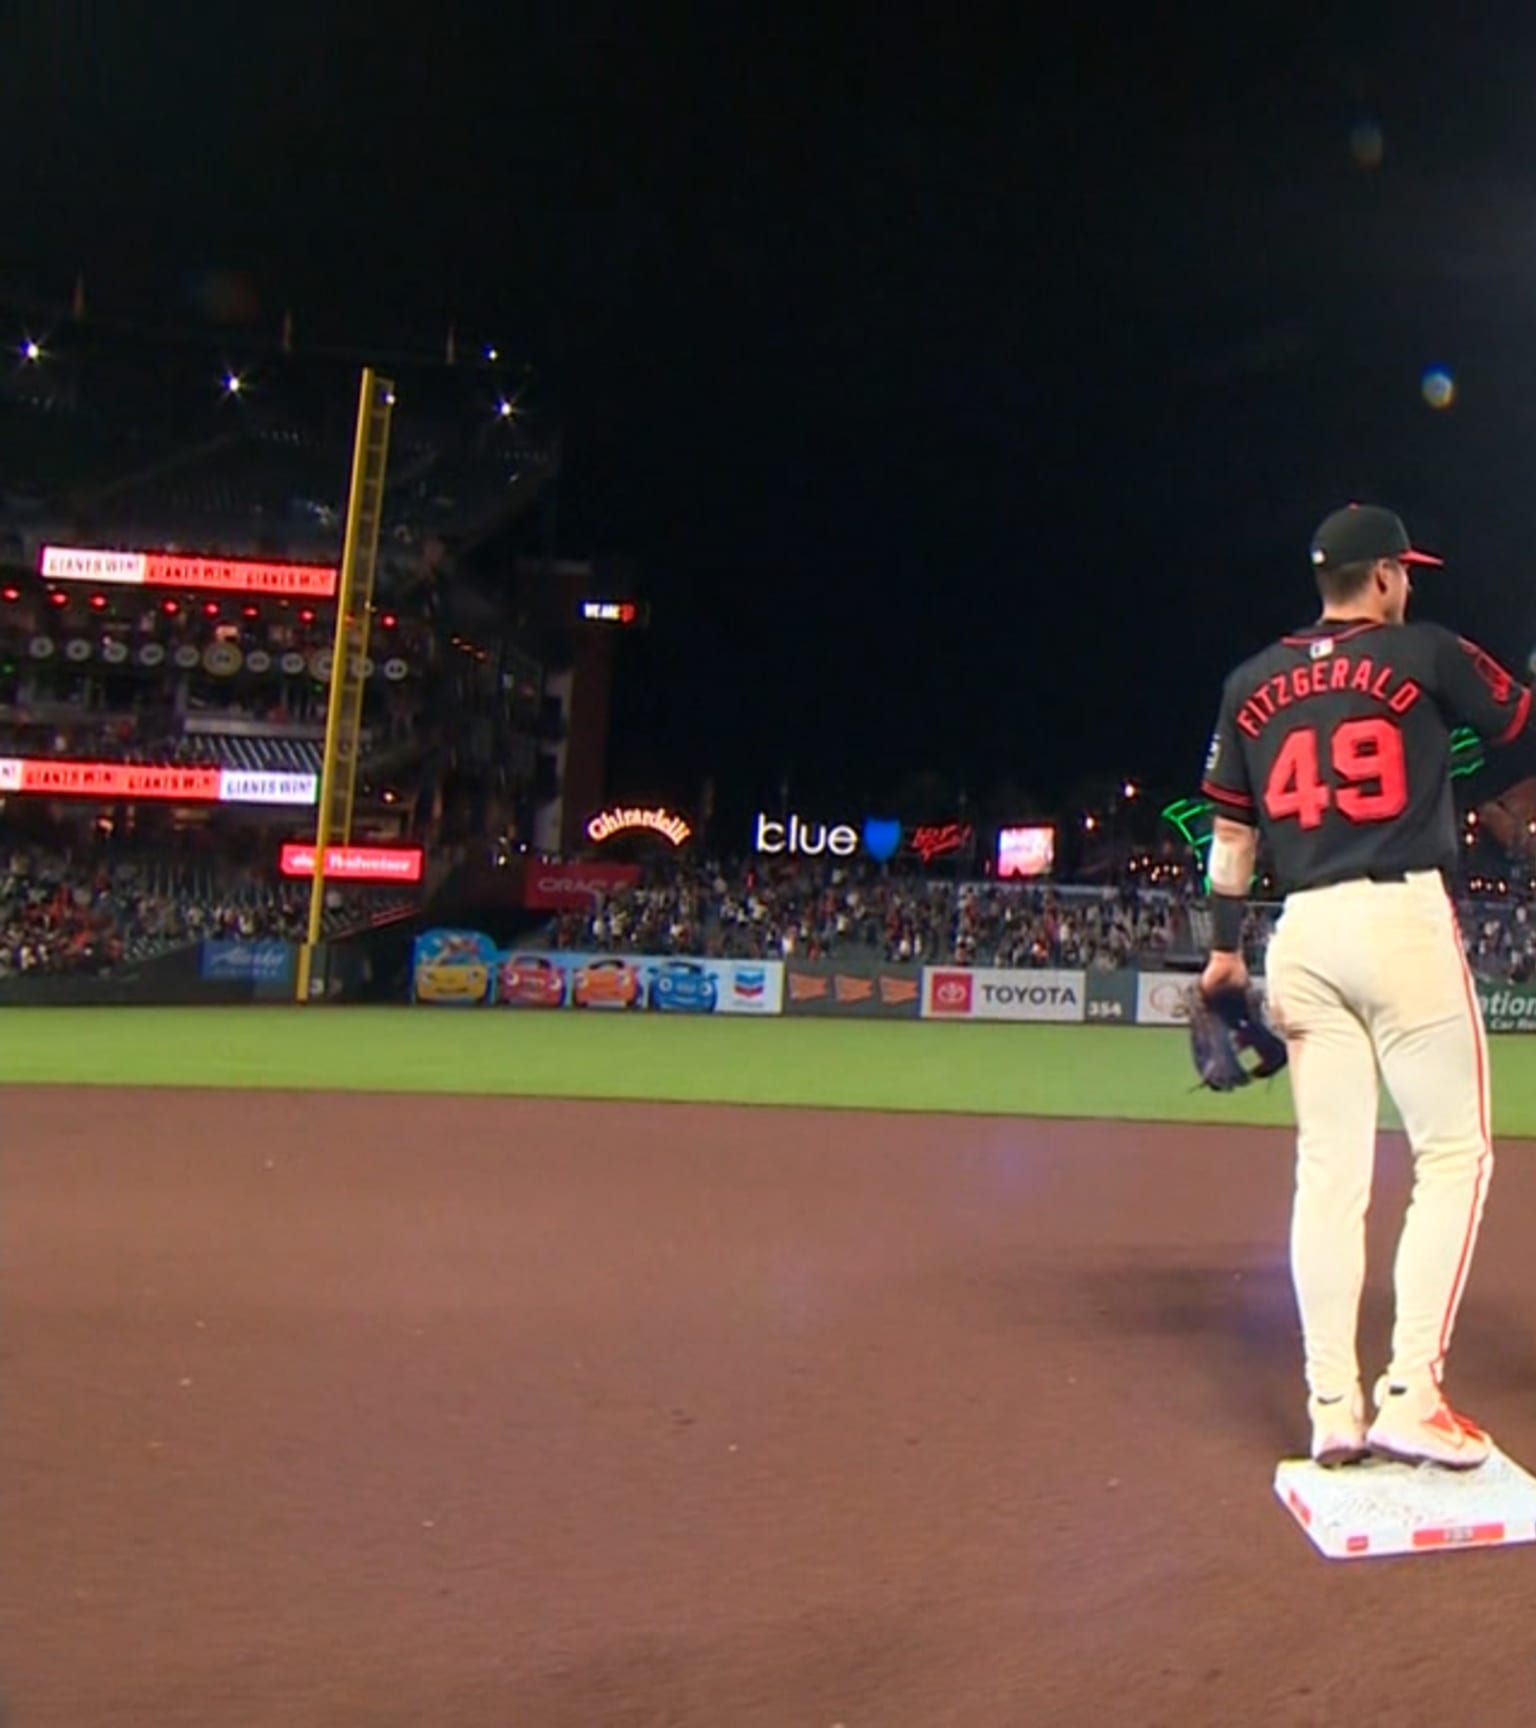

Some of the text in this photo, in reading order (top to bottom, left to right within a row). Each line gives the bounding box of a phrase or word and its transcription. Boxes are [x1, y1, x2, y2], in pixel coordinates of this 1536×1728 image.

[1236, 656, 1422, 738] FITZGERALD
[1263, 717, 1409, 831] 49
[587, 806, 692, 846] Ghirardelli
[756, 812, 858, 855] blue
[981, 983, 1077, 1006] TOYOTA
